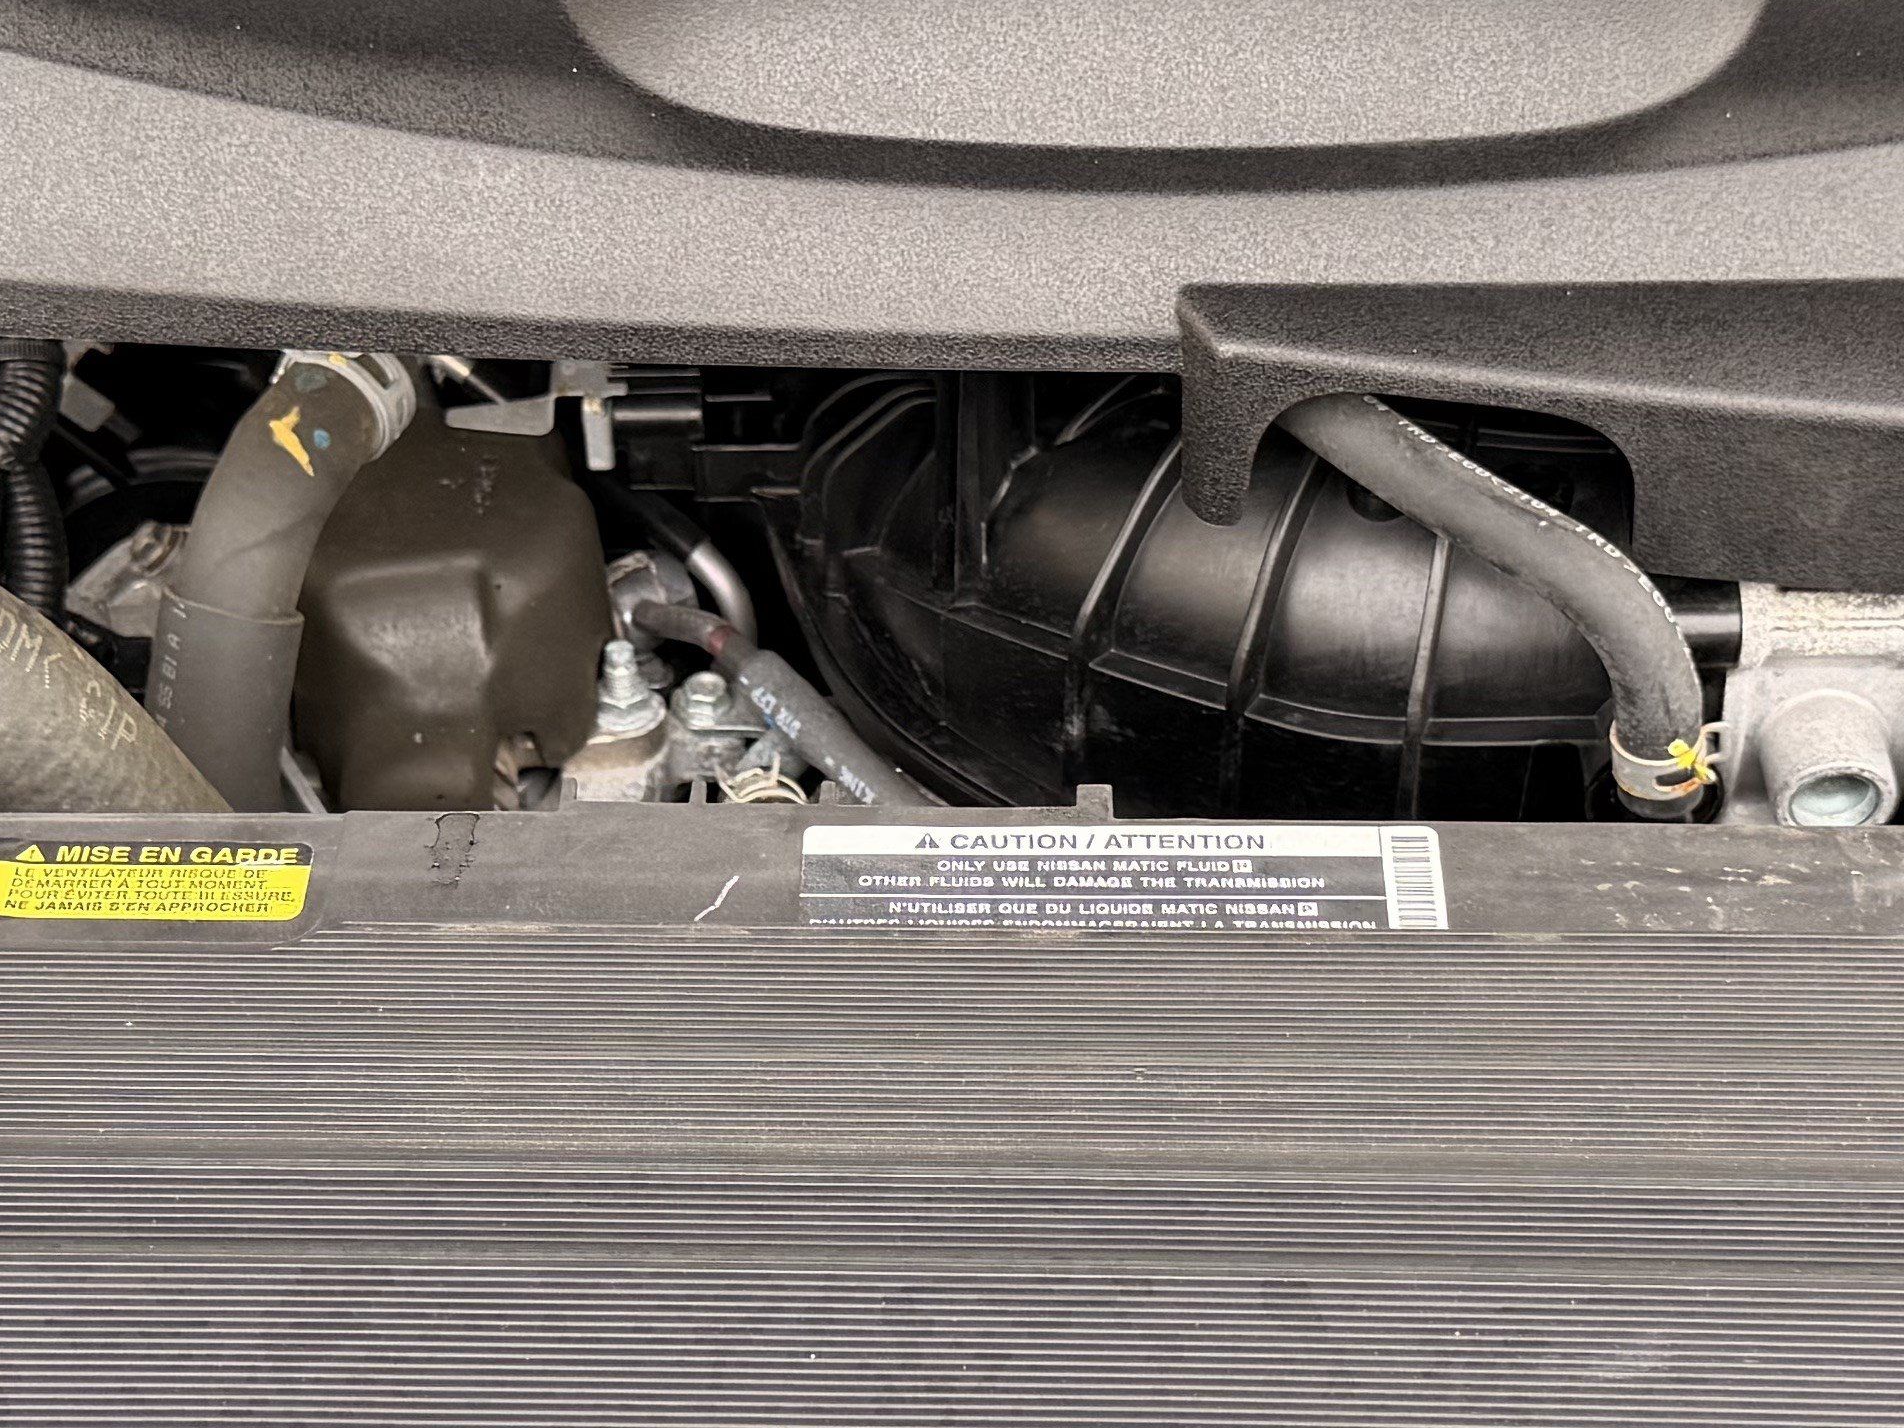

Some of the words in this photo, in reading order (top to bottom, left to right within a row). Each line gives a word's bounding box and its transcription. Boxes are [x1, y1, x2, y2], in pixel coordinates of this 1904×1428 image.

[950, 834, 1078, 850] CAUTION
[1085, 834, 1095, 849] /
[1103, 834, 1265, 850] ATTENTION
[55, 845, 131, 863] MISE
[138, 846, 183, 863] EN
[189, 847, 299, 864] GARDE
[14, 866, 35, 878] LE
[42, 867, 164, 878] VENTILATEUR
[169, 868, 237, 879] RISQUE
[245, 869, 268, 879] DE
[937, 860, 986, 872] ONLY
[992, 860, 1030, 872] USE
[1037, 860, 1106, 872] NISSAN
[1112, 860, 1169, 872] MATIC
[1176, 860, 1231, 872] FLUID
[136, 879, 183, 889] TOUT
[858, 875, 922, 887] OTHER
[929, 876, 994, 888] FLUIDS
[1001, 876, 1046, 888] WILL
[1053, 876, 1133, 888] DAMAGE
[1140, 877, 1176, 888] THE
[1183, 877, 1325, 888] TRANSMISSION
[8, 888, 59, 899] POUR
[135, 890, 193, 900] TOUTE
[4, 899, 29, 910] NE
[35, 900, 102, 911] JAMAIS
[888, 902, 991, 914] N'UTILISER
[998, 902, 1038, 914] QUE
[1045, 903, 1072, 914] DU
[1078, 903, 1153, 914] LIQUIDE
[1160, 903, 1218, 915] MATIC
[1225, 903, 1295, 915] NISSAN
